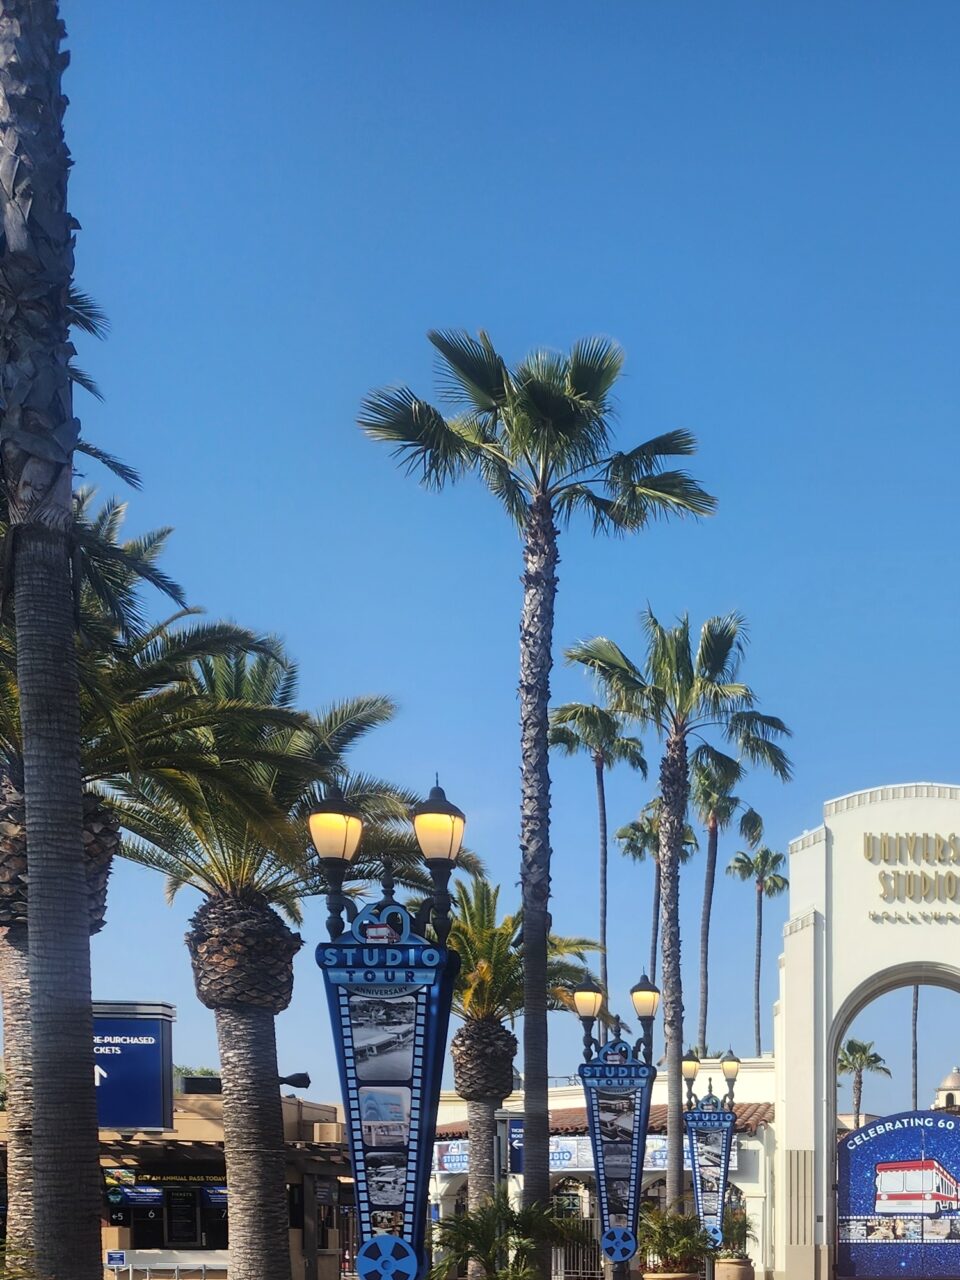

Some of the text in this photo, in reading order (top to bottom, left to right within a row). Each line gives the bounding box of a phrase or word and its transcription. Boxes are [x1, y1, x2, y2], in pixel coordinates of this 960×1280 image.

[323, 947, 440, 967] STUDIO
[345, 969, 416, 983] TOUR
[353, 985, 408, 996] ANNIVERSARY
[93, 1035, 156, 1044] RE-PURCHASED
[93, 1046, 122, 1055] CKETS
[583, 1066, 649, 1078] STUDIO
[686, 1113, 733, 1121] STUDIO
[847, 1117, 934, 1150] CELEBRATING
[937, 1119, 955, 1130] 60
[117, 1212, 124, 1221] 5
[148, 1209, 156, 1219] 6
